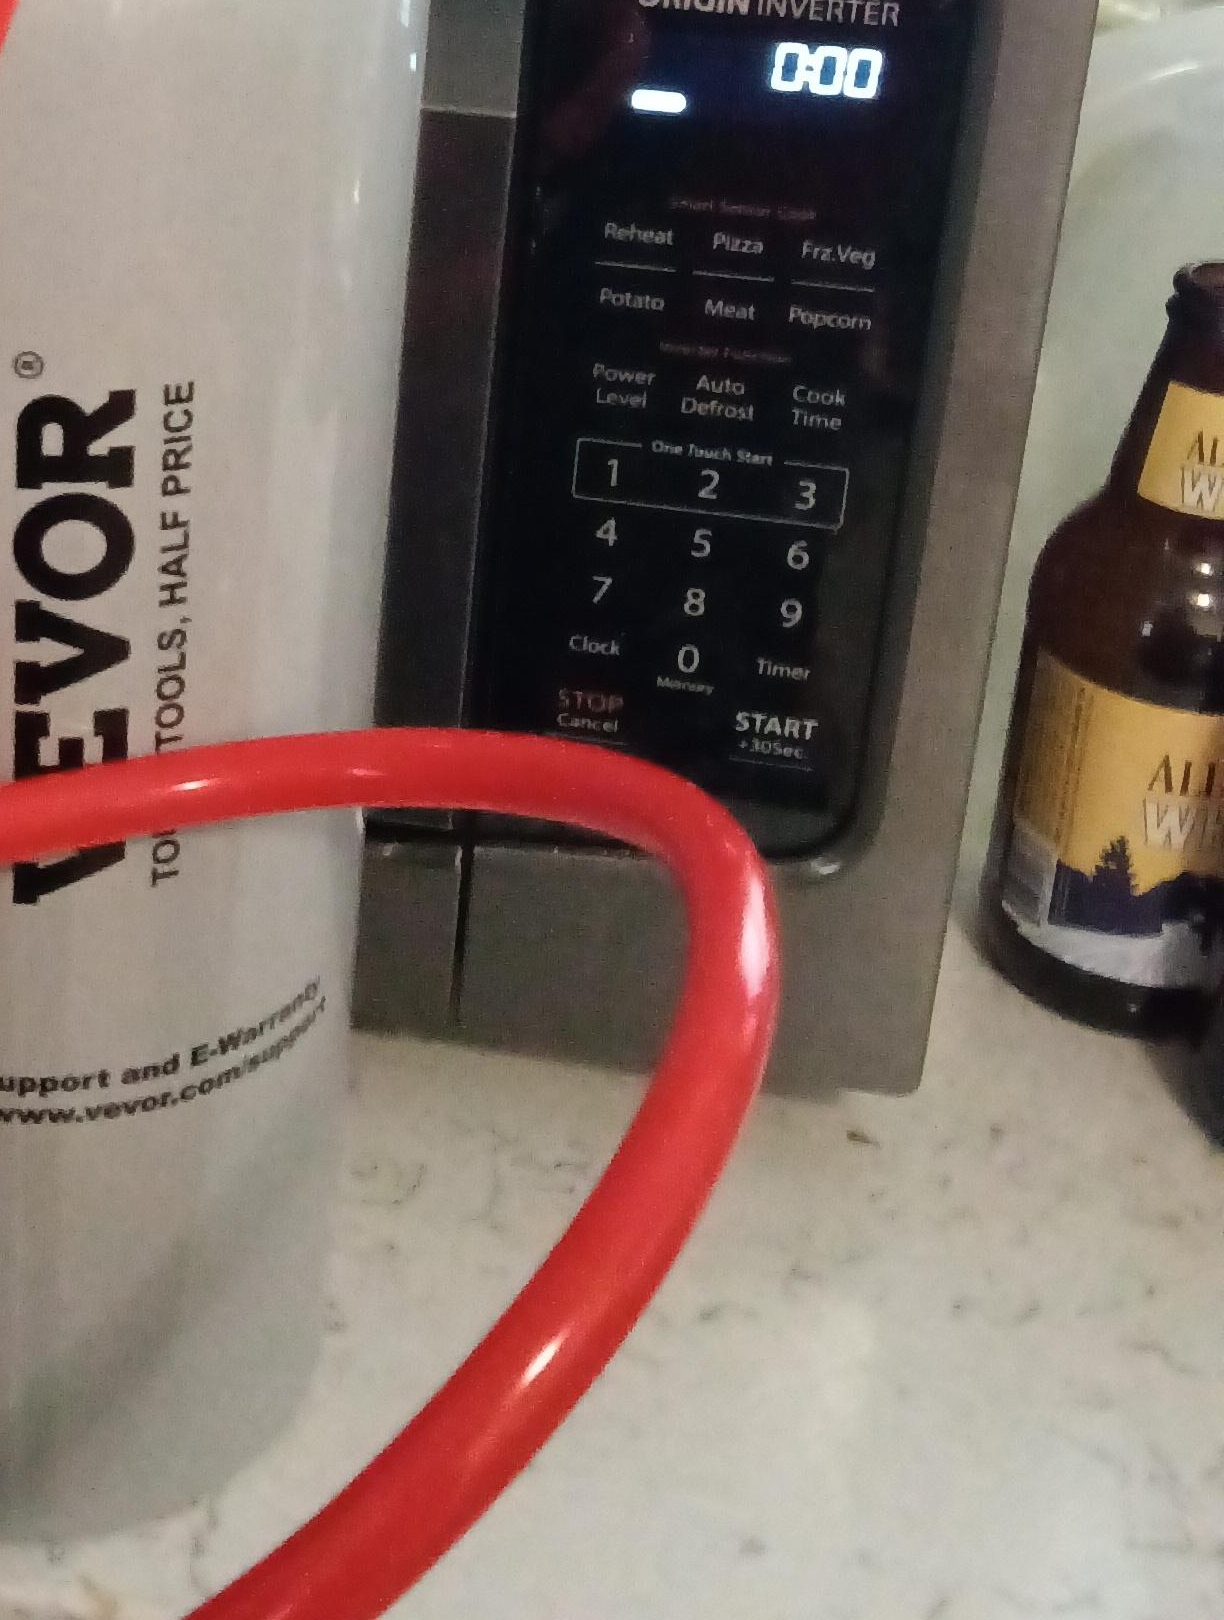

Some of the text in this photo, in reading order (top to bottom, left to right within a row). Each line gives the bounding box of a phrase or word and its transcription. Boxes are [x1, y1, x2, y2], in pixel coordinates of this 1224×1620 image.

[770, 42, 883, 99] 0:00
[604, 222, 673, 246] Reheat
[713, 232, 763, 255] Pizza
[600, 288, 665, 311] Potato
[705, 299, 755, 321] Meat
[789, 305, 872, 330] Popcorn
[592, 363, 656, 386] Power
[696, 375, 745, 396] Auto
[596, 389, 648, 409] Level
[681, 397, 754, 421] Defrost
[793, 385, 846, 407] Cook
[792, 409, 842, 430] Time
[161, 380, 195, 497] PRICE
[652, 440, 773, 466] One Touch Start
[606, 459, 620, 487] 1
[698, 470, 720, 499] 2
[795, 480, 817, 511] 3
[595, 517, 618, 547] 4
[690, 529, 713, 558] 5
[157, 511, 190, 608] HALF
[787, 540, 810, 570] 6
[592, 576, 613, 604] 7
[684, 588, 706, 616] 8
[780, 598, 803, 629] 9
[569, 634, 621, 657] Clock
[677, 644, 700, 673] 0
[756, 657, 811, 681] Timer
[656, 676, 715, 696] Memory
[558, 687, 624, 713] STOP
[556, 712, 619, 734] Cancel
[735, 711, 819, 741] START
[121, 1051, 180, 1085] and
[190, 975, 320, 1067] E-Warranty
